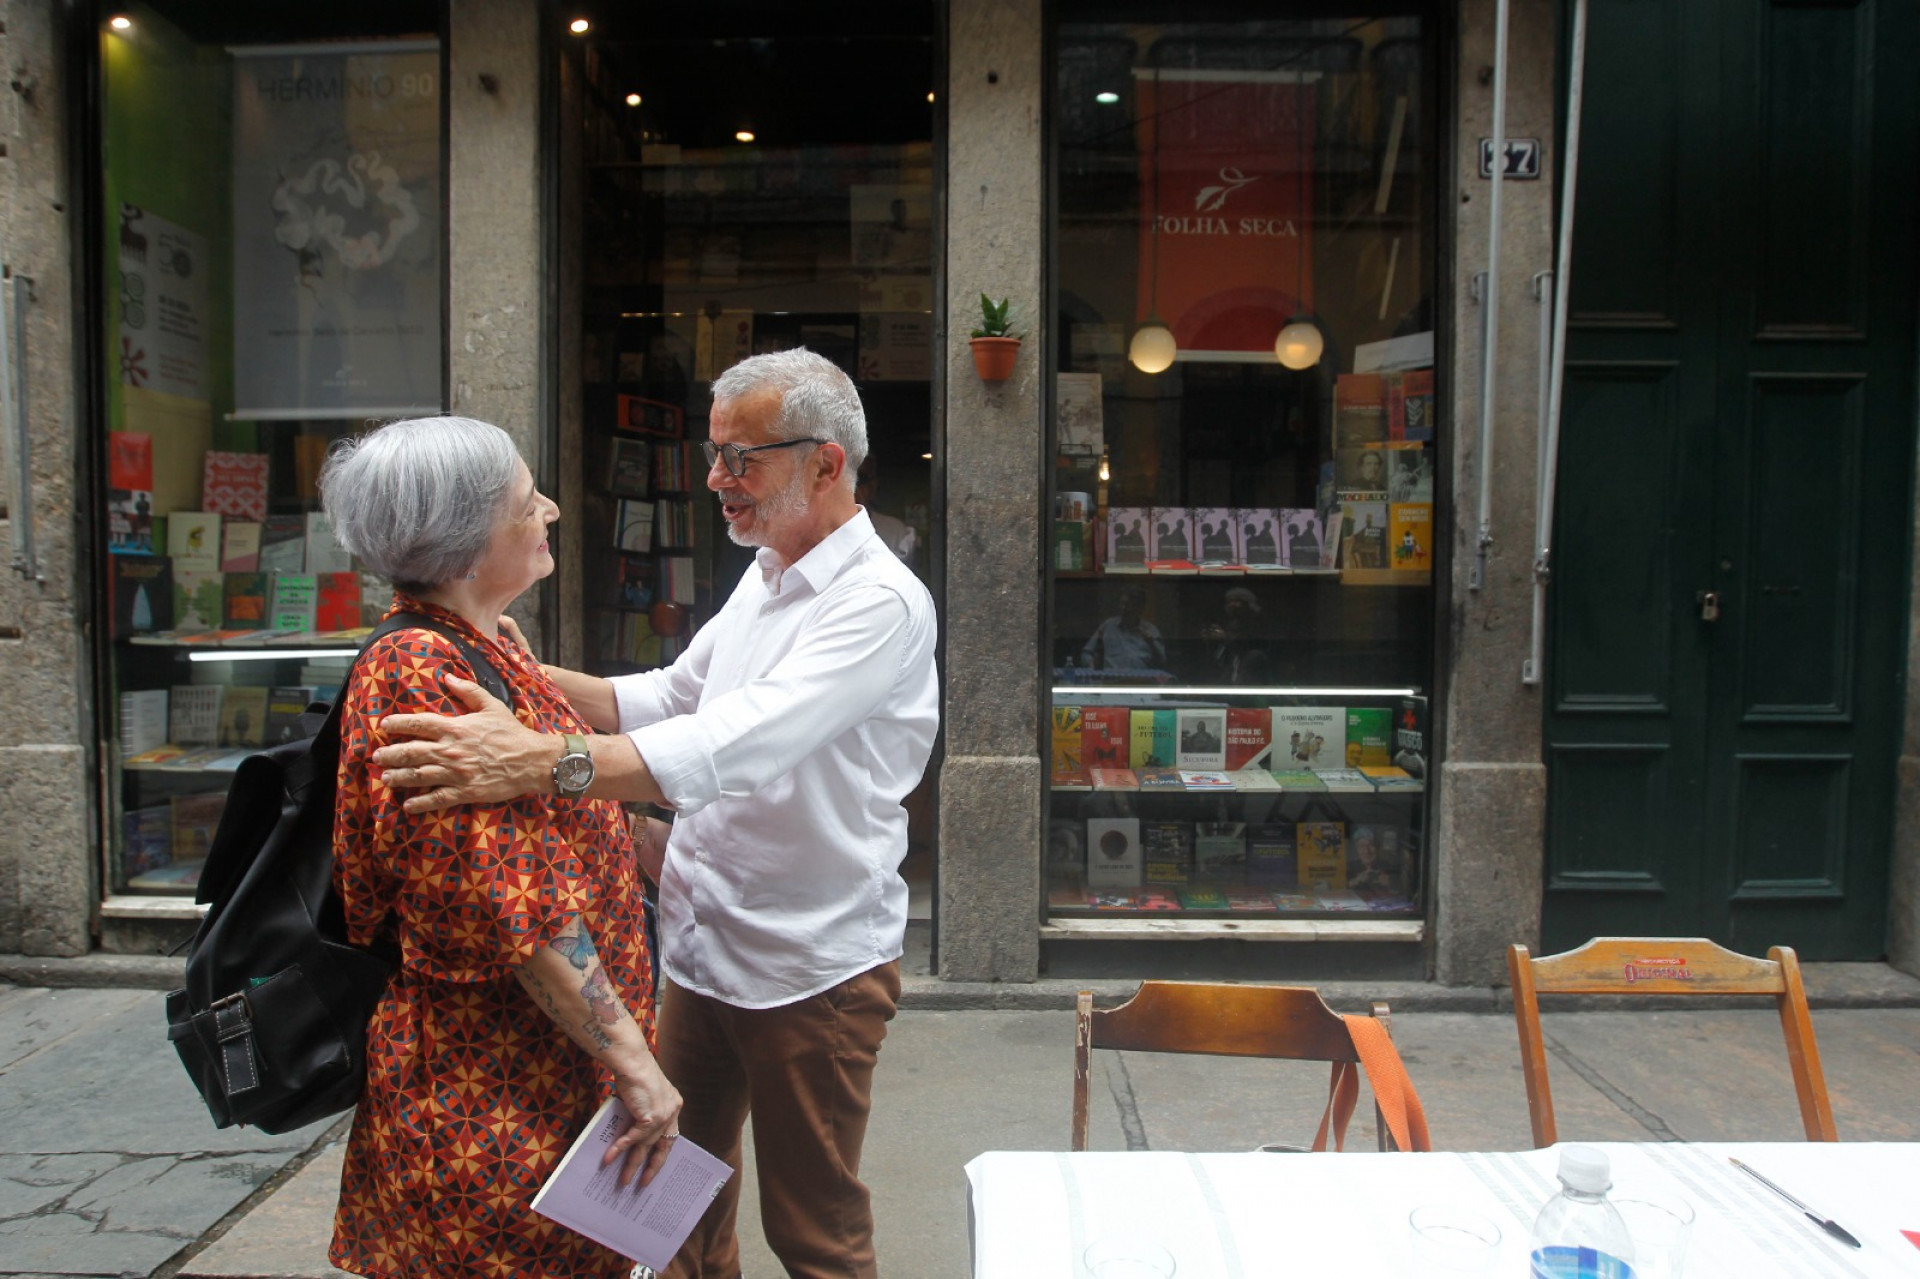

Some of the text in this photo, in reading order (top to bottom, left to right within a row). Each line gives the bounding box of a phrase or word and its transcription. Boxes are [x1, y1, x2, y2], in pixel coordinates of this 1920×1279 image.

[401, 72, 433, 97] 90
[1152, 214, 1298, 237] FOLHA SECA
[1336, 493, 1389, 502] MACHADO
[1397, 730, 1422, 751] VASCO
